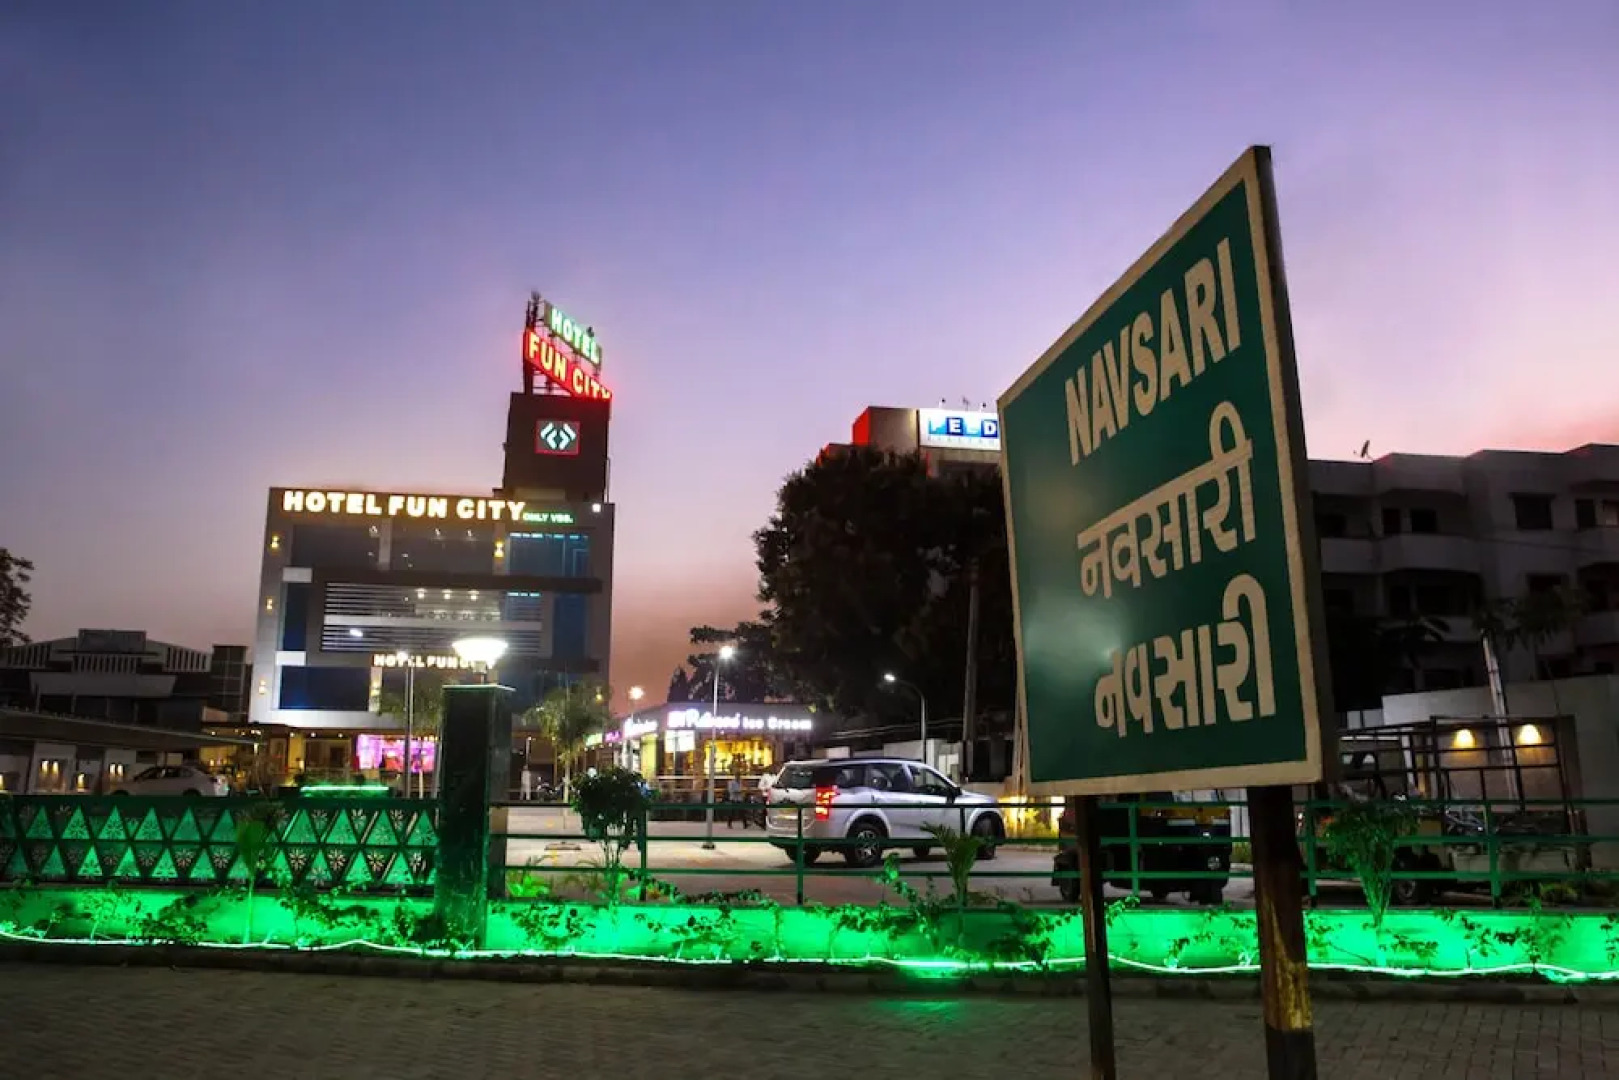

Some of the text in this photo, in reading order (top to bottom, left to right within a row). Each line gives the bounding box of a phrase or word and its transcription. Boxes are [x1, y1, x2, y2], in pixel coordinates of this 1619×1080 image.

[528, 331, 567, 382] FUN
[551, 307, 600, 364] HOTEL
[1065, 237, 1241, 466] NAVSARI
[283, 490, 525, 521] HOTEL FUN CITY
[1077, 401, 1256, 598] नवसारी
[1095, 574, 1276, 737] નવસારી
